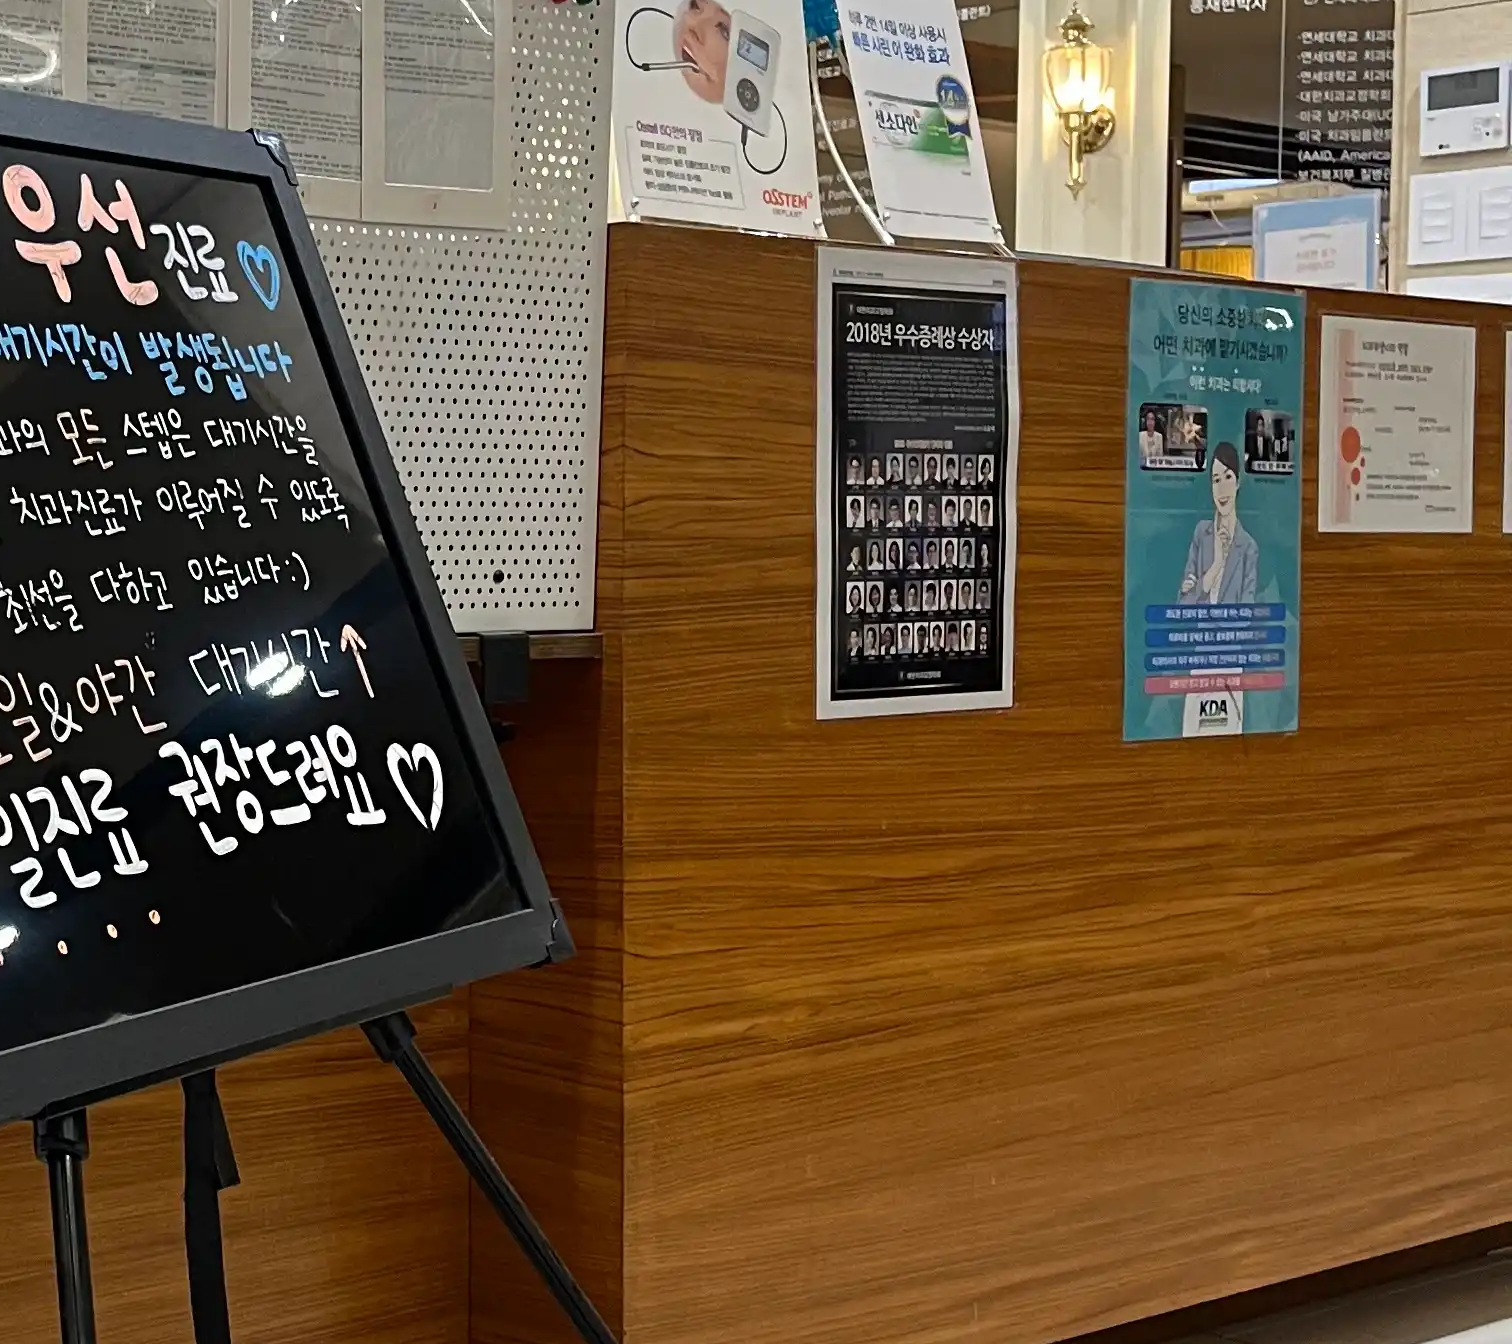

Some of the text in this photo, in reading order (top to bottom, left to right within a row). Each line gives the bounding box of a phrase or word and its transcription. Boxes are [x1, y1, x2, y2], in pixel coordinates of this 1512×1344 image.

[899, 22, 917, 40] 이상
[904, 41, 925, 63] 완화
[926, 45, 951, 66] 효과
[875, 108, 919, 135] 센소다인
[763, 188, 808, 210] OSSTEM
[2, 164, 158, 305] 우선
[149, 223, 239, 303] 진료
[1178, 305, 1213, 325] 당신의
[846, 322, 994, 351] 2018년 우수증례상 수상자
[1154, 334, 1178, 355] 어떤
[1183, 337, 1217, 358] 치과에
[142, 332, 293, 401] 발생됩니다
[57, 408, 108, 469] 모든
[123, 408, 196, 459] 스텝은
[208, 415, 317, 465] 대기시간을
[10, 485, 142, 536] 치과진료가
[157, 478, 251, 529] 이루어질
[257, 473, 280, 518] 수
[289, 478, 352, 531] 있도록
[90, 561, 173, 611] 다하고
[1199, 700, 1227, 717] KDA
[159, 725, 385, 855] 권장드려요
